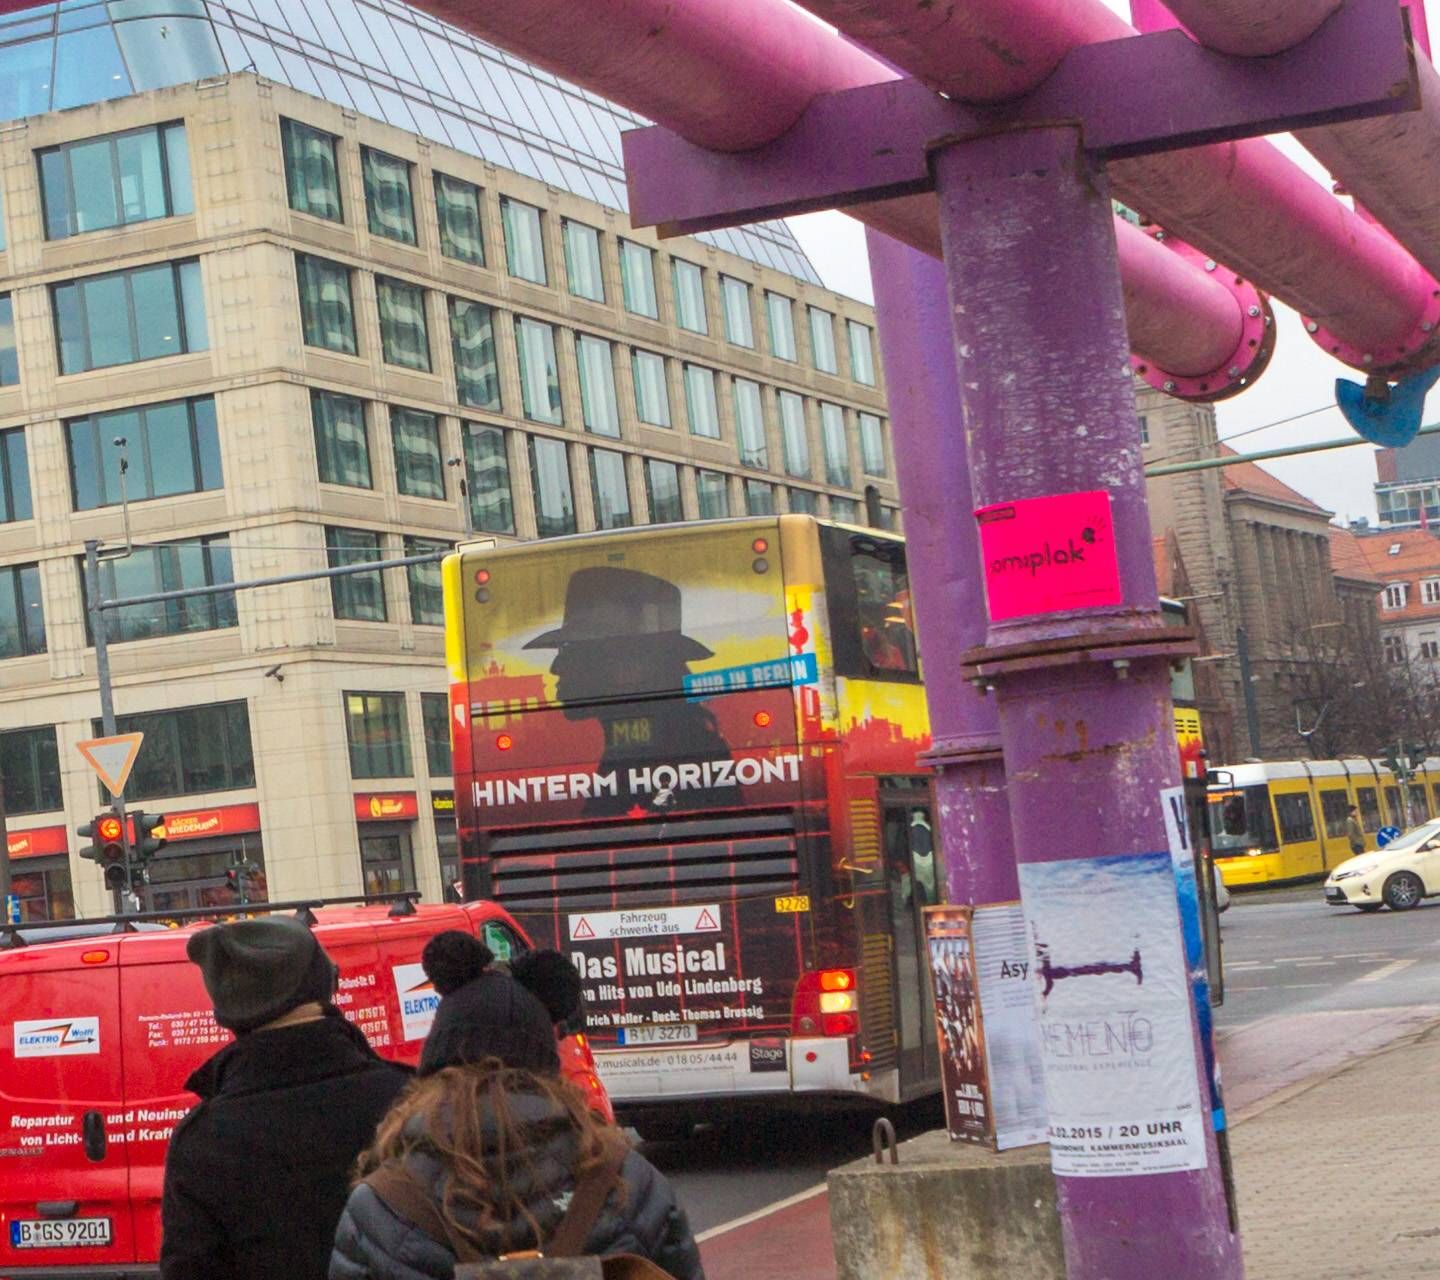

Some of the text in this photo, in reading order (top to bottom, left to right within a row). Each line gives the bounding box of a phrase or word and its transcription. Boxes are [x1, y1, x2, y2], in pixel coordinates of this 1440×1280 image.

[691, 659, 808, 696] NUR IN BERLIN
[611, 718, 651, 746] M48
[472, 753, 804, 807] HINTERM HORIZONT
[777, 897, 809, 911] 3278
[619, 912, 667, 925] Fahrzeug
[609, 923, 681, 937] schwenkt aus
[572, 942, 727, 980] Das Musical
[599, 984, 626, 1001] Hits
[628, 983, 654, 999] von
[656, 980, 682, 998] Udo
[684, 975, 764, 996] Lindenberg
[652, 1010, 680, 1023] Buch:
[682, 1007, 722, 1021] Thomas
[723, 1005, 764, 1020] Brussig
[19, 1034, 60, 1046] ELEKTRO
[71, 1027, 95, 1039] Wolff
[658, 1026, 692, 1040] 3278
[751, 1047, 784, 1060] Stage
[10, 1114, 75, 1131] Reparatur
[107, 1111, 134, 1124] und
[1119, 1124, 1140, 1137] 20
[1146, 1121, 1183, 1136] UHR
[20, 1134, 43, 1147] von
[46, 1132, 83, 1146] Licht-
[108, 1130, 136, 1143] und
[21, 1221, 108, 1242] B GS 9201
